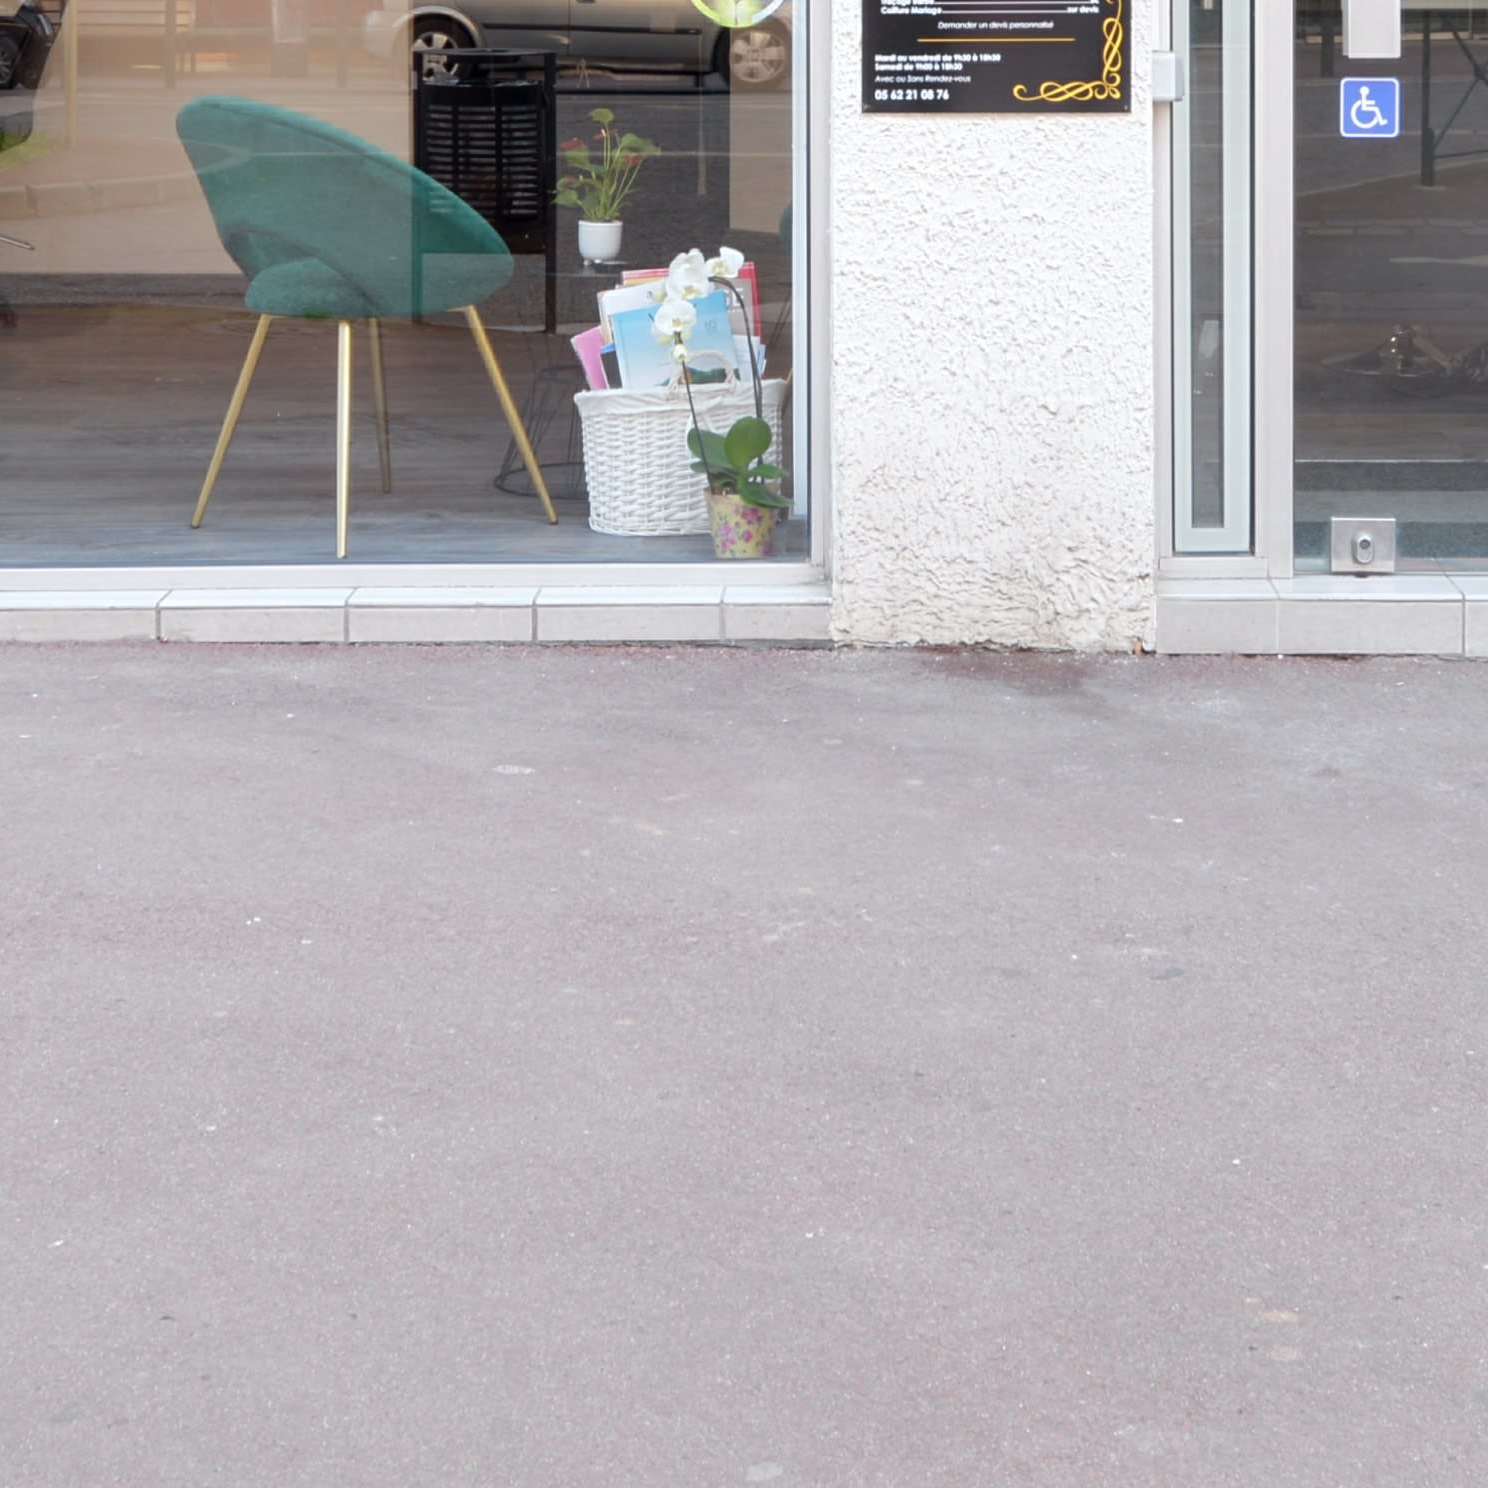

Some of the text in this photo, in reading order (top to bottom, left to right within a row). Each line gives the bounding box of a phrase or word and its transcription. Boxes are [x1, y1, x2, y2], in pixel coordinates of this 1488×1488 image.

[874, 89, 888, 100] 05
[890, 89, 903, 100] 62
[905, 89, 918, 100] 21
[936, 89, 950, 100] 76
